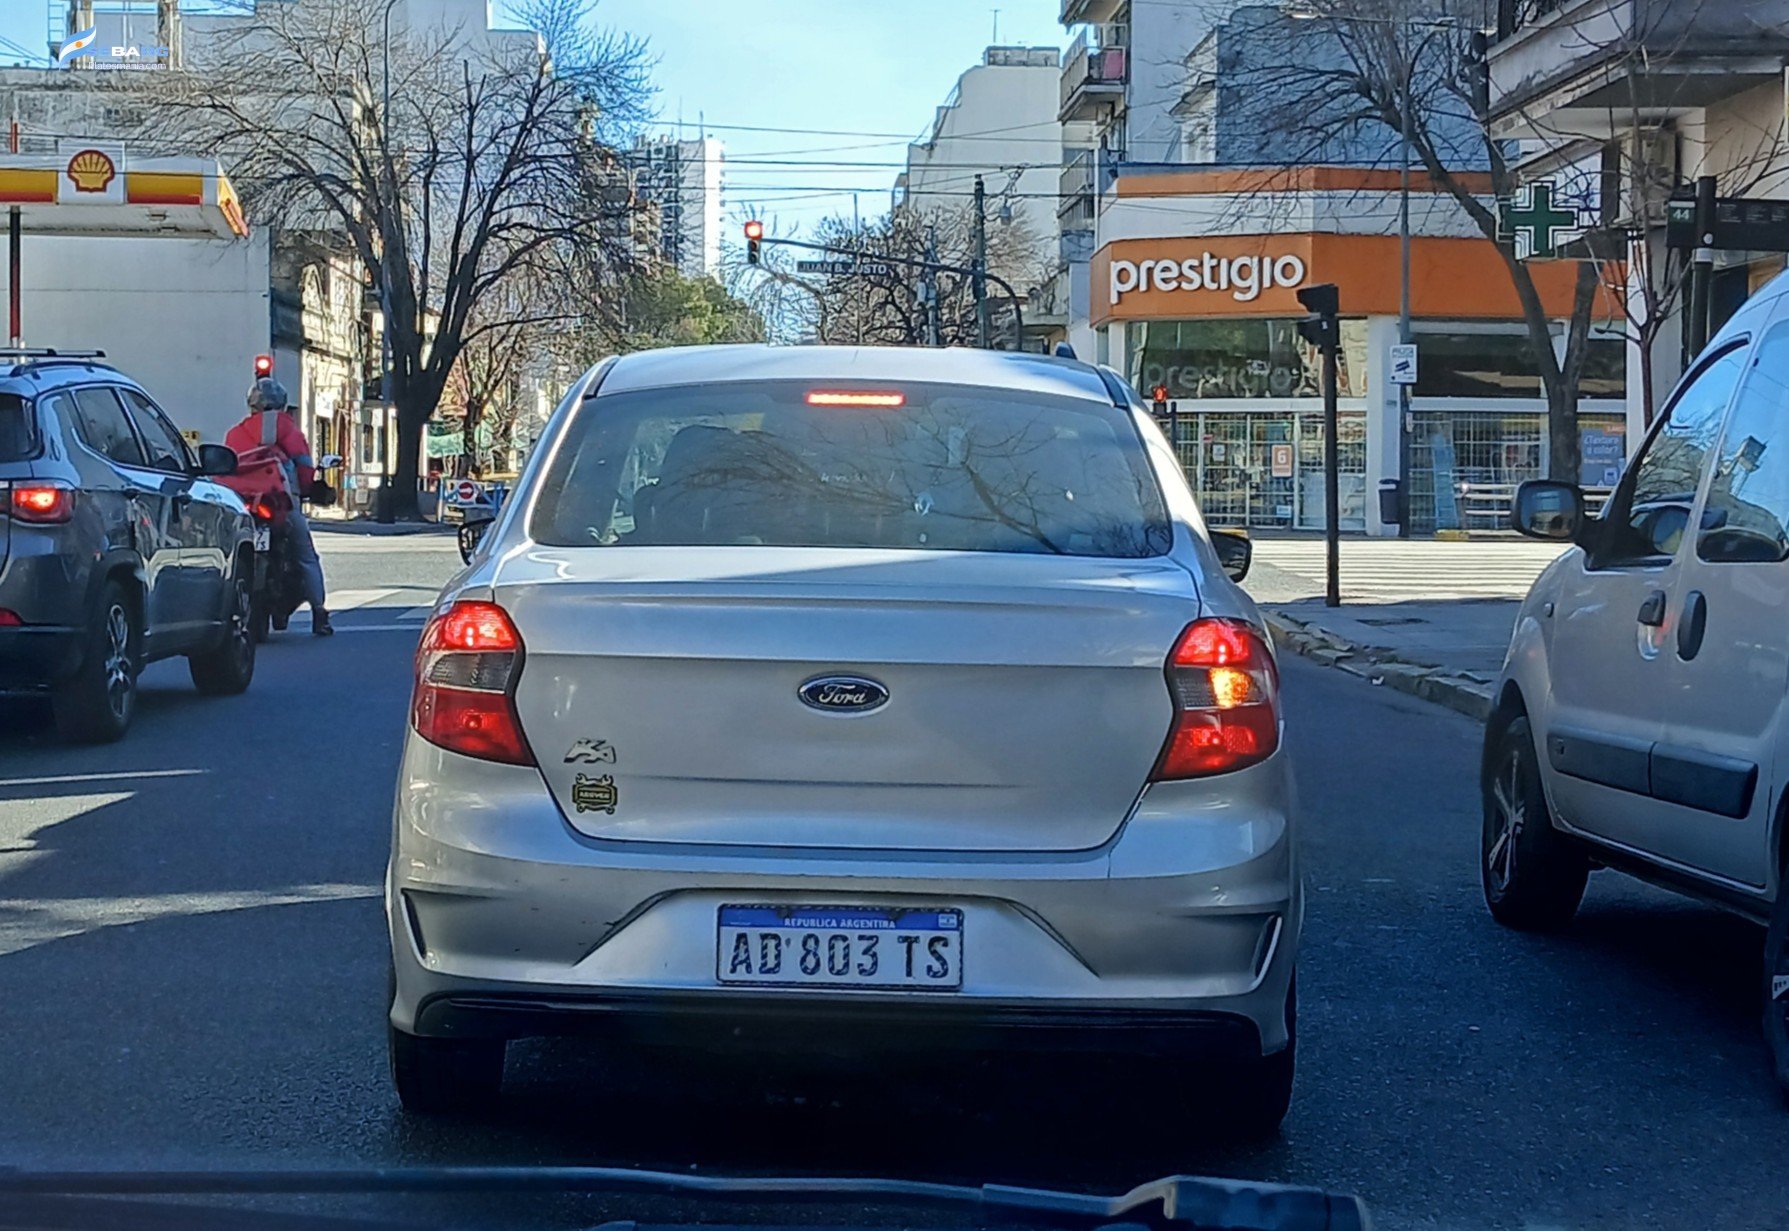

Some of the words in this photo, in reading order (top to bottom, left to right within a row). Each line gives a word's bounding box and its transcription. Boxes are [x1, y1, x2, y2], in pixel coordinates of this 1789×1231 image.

[1673, 209, 1690, 220] 44
[801, 262, 832, 272] JUAN
[848, 264, 887, 274] JUSTO
[1110, 251, 1304, 304] prestigio
[1277, 450, 1287, 464] 6
[818, 684, 868, 703] Ford
[784, 917, 838, 928] REPUBLICA
[839, 918, 896, 929] ARGENTINA
[729, 932, 782, 975] AD
[800, 933, 880, 977] 803
[898, 935, 950, 979] TS
